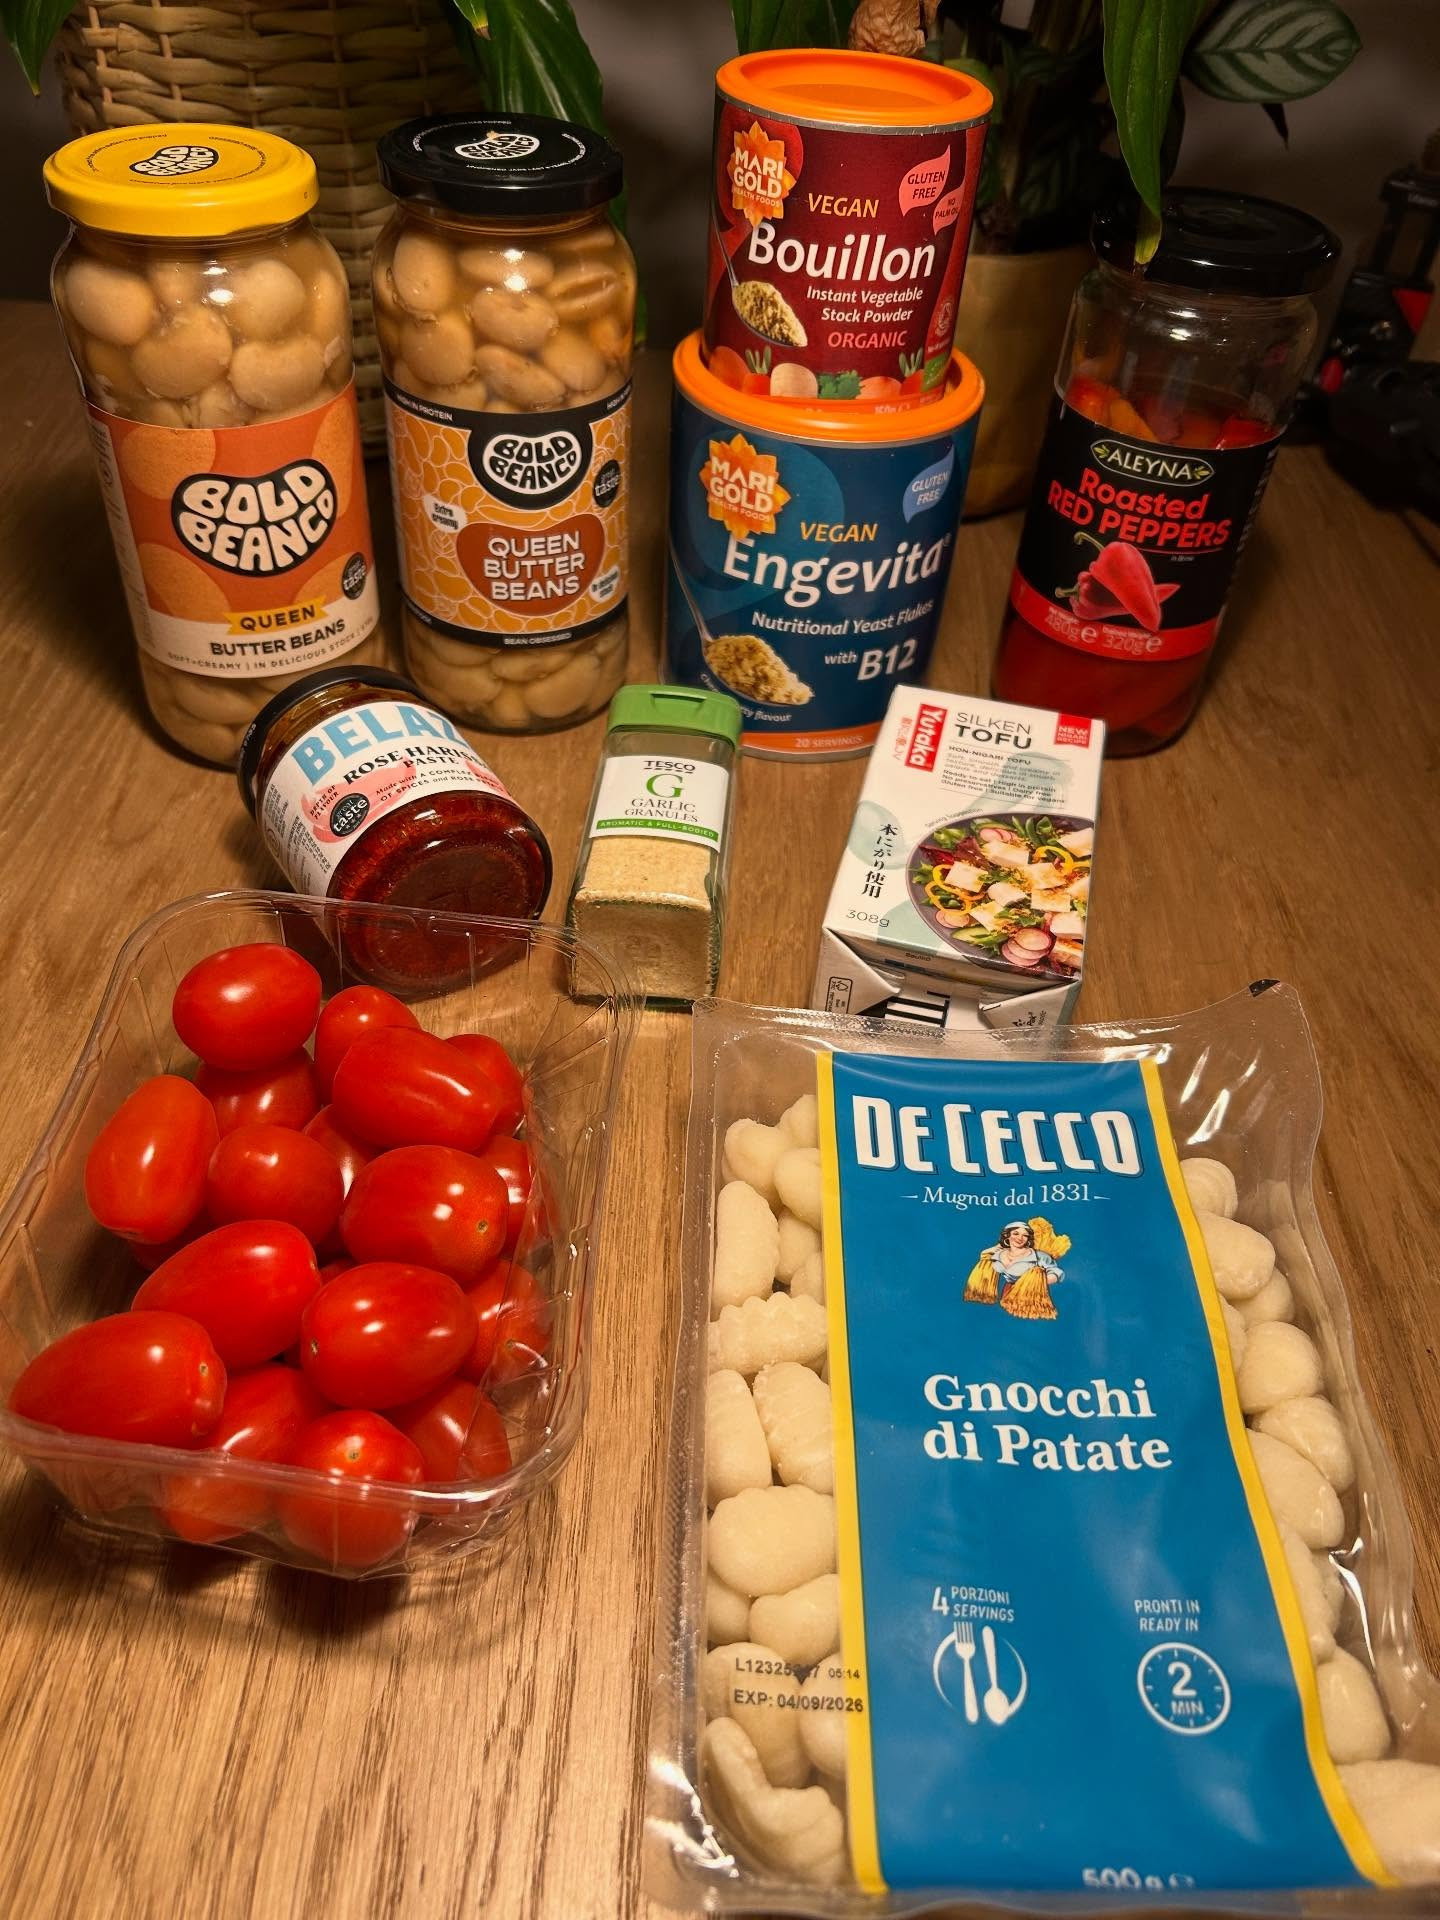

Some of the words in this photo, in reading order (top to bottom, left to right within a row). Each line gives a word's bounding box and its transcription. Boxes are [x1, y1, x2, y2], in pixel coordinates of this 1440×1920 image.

[735, 146, 783, 180] MARI
[734, 167, 782, 198] GOLD
[908, 170, 946, 185] GLUTEN
[808, 193, 879, 218] VEGAN
[912, 187, 937, 200] FREE
[748, 222, 936, 282] Bouillon
[807, 285, 857, 303] Instant
[861, 286, 923, 307] Vegetable
[821, 307, 860, 323] Stock
[864, 308, 913, 323] Powder
[827, 330, 908, 349] ORGANIC
[419, 404, 453, 421] PROTEIN
[494, 436, 573, 463] BOLD
[711, 455, 775, 494] MARI
[1107, 448, 1194, 480] ALEYNA
[911, 471, 949, 493] GLUTEN
[1078, 467, 1210, 520] Roasted
[183, 465, 325, 525] BOLD
[710, 476, 773, 513] GOLD
[916, 488, 941, 506] FREE
[1047, 480, 1095, 526] RED
[1099, 509, 1232, 549] PEPPERS
[800, 521, 878, 543] VEGAN
[488, 531, 580, 559] QUEEN
[483, 552, 586, 580] BUTTER
[491, 575, 580, 601] BEANS
[240, 604, 315, 631] QUEEN
[752, 611, 850, 636] Nutritional
[852, 616, 894, 634] Yeast
[896, 600, 934, 626] Flakes
[210, 638, 286, 656] BUTTER
[291, 619, 346, 649] BEANS
[530, 633, 572, 645] OBSESSED
[1103, 636, 1145, 655] 320g
[271, 648, 326, 668] DELICIOUS
[824, 650, 858, 666] with
[857, 638, 919, 681] B12
[754, 710, 792, 722] flavour
[956, 712, 1032, 735] SILKEN
[812, 735, 864, 748] SERVINGS
[908, 706, 943, 767] Yutaka
[954, 724, 1032, 750] TOFU
[1057, 737, 1087, 745] RECIPE
[1059, 725, 1089, 735] NEW
[343, 750, 405, 784] ROSE
[403, 757, 460, 768] PASTE
[644, 761, 696, 773] TESCO
[948, 746, 1004, 761] HON-NIGARI
[1007, 757, 1031, 766] TOFU
[376, 781, 398, 795] Made
[400, 775, 417, 785] with
[380, 793, 393, 802] OF
[396, 780, 430, 795] SPICES
[646, 773, 685, 798] G
[941, 779, 966, 789] Gluten
[968, 784, 984, 792] free
[989, 789, 1022, 799] Suitable
[943, 769, 967, 779] Ready
[998, 780, 1017, 788] High
[1027, 784, 1056, 793] protein
[1013, 786, 1034, 796] Dairy
[310, 794, 327, 817] DEPTH
[327, 785, 337, 794] OF
[314, 791, 340, 820] FLAVOUR
[631, 798, 696, 813] GARLIC
[333, 799, 368, 832] taste
[624, 808, 699, 823] GRANULES
[600, 819, 645, 827] AROMATIC
[656, 820, 715, 838] FULL-BODIED
[860, 822, 899, 899] 本にがり使用
[845, 907, 890, 928] 308g
[852, 1094, 936, 1175] DE
[943, 1103, 1144, 1177] CECCO
[922, 1186, 998, 1211] Mugnai
[1004, 1187, 1034, 1206] dal
[1040, 1184, 1090, 1203] 1831
[923, 1373, 1157, 1419] Gnocchi
[923, 1421, 984, 1461] di
[992, 1423, 1173, 1471] Patate
[932, 1586, 950, 1616] 4
[951, 1586, 1010, 1605] PORZIONI
[953, 1603, 1015, 1623] SERVINGS
[1134, 1599, 1183, 1614] PRONTI
[1186, 1600, 1200, 1613] IN
[1139, 1617, 1182, 1632] READY
[1185, 1617, 1199, 1631] IN
[735, 1657, 820, 1679] L123257
[1167, 1660, 1197, 1697] 2
[734, 1688, 773, 1707] EXP:
[777, 1693, 864, 1713] 04/09/2026
[1171, 1700, 1204, 1715] MIN
